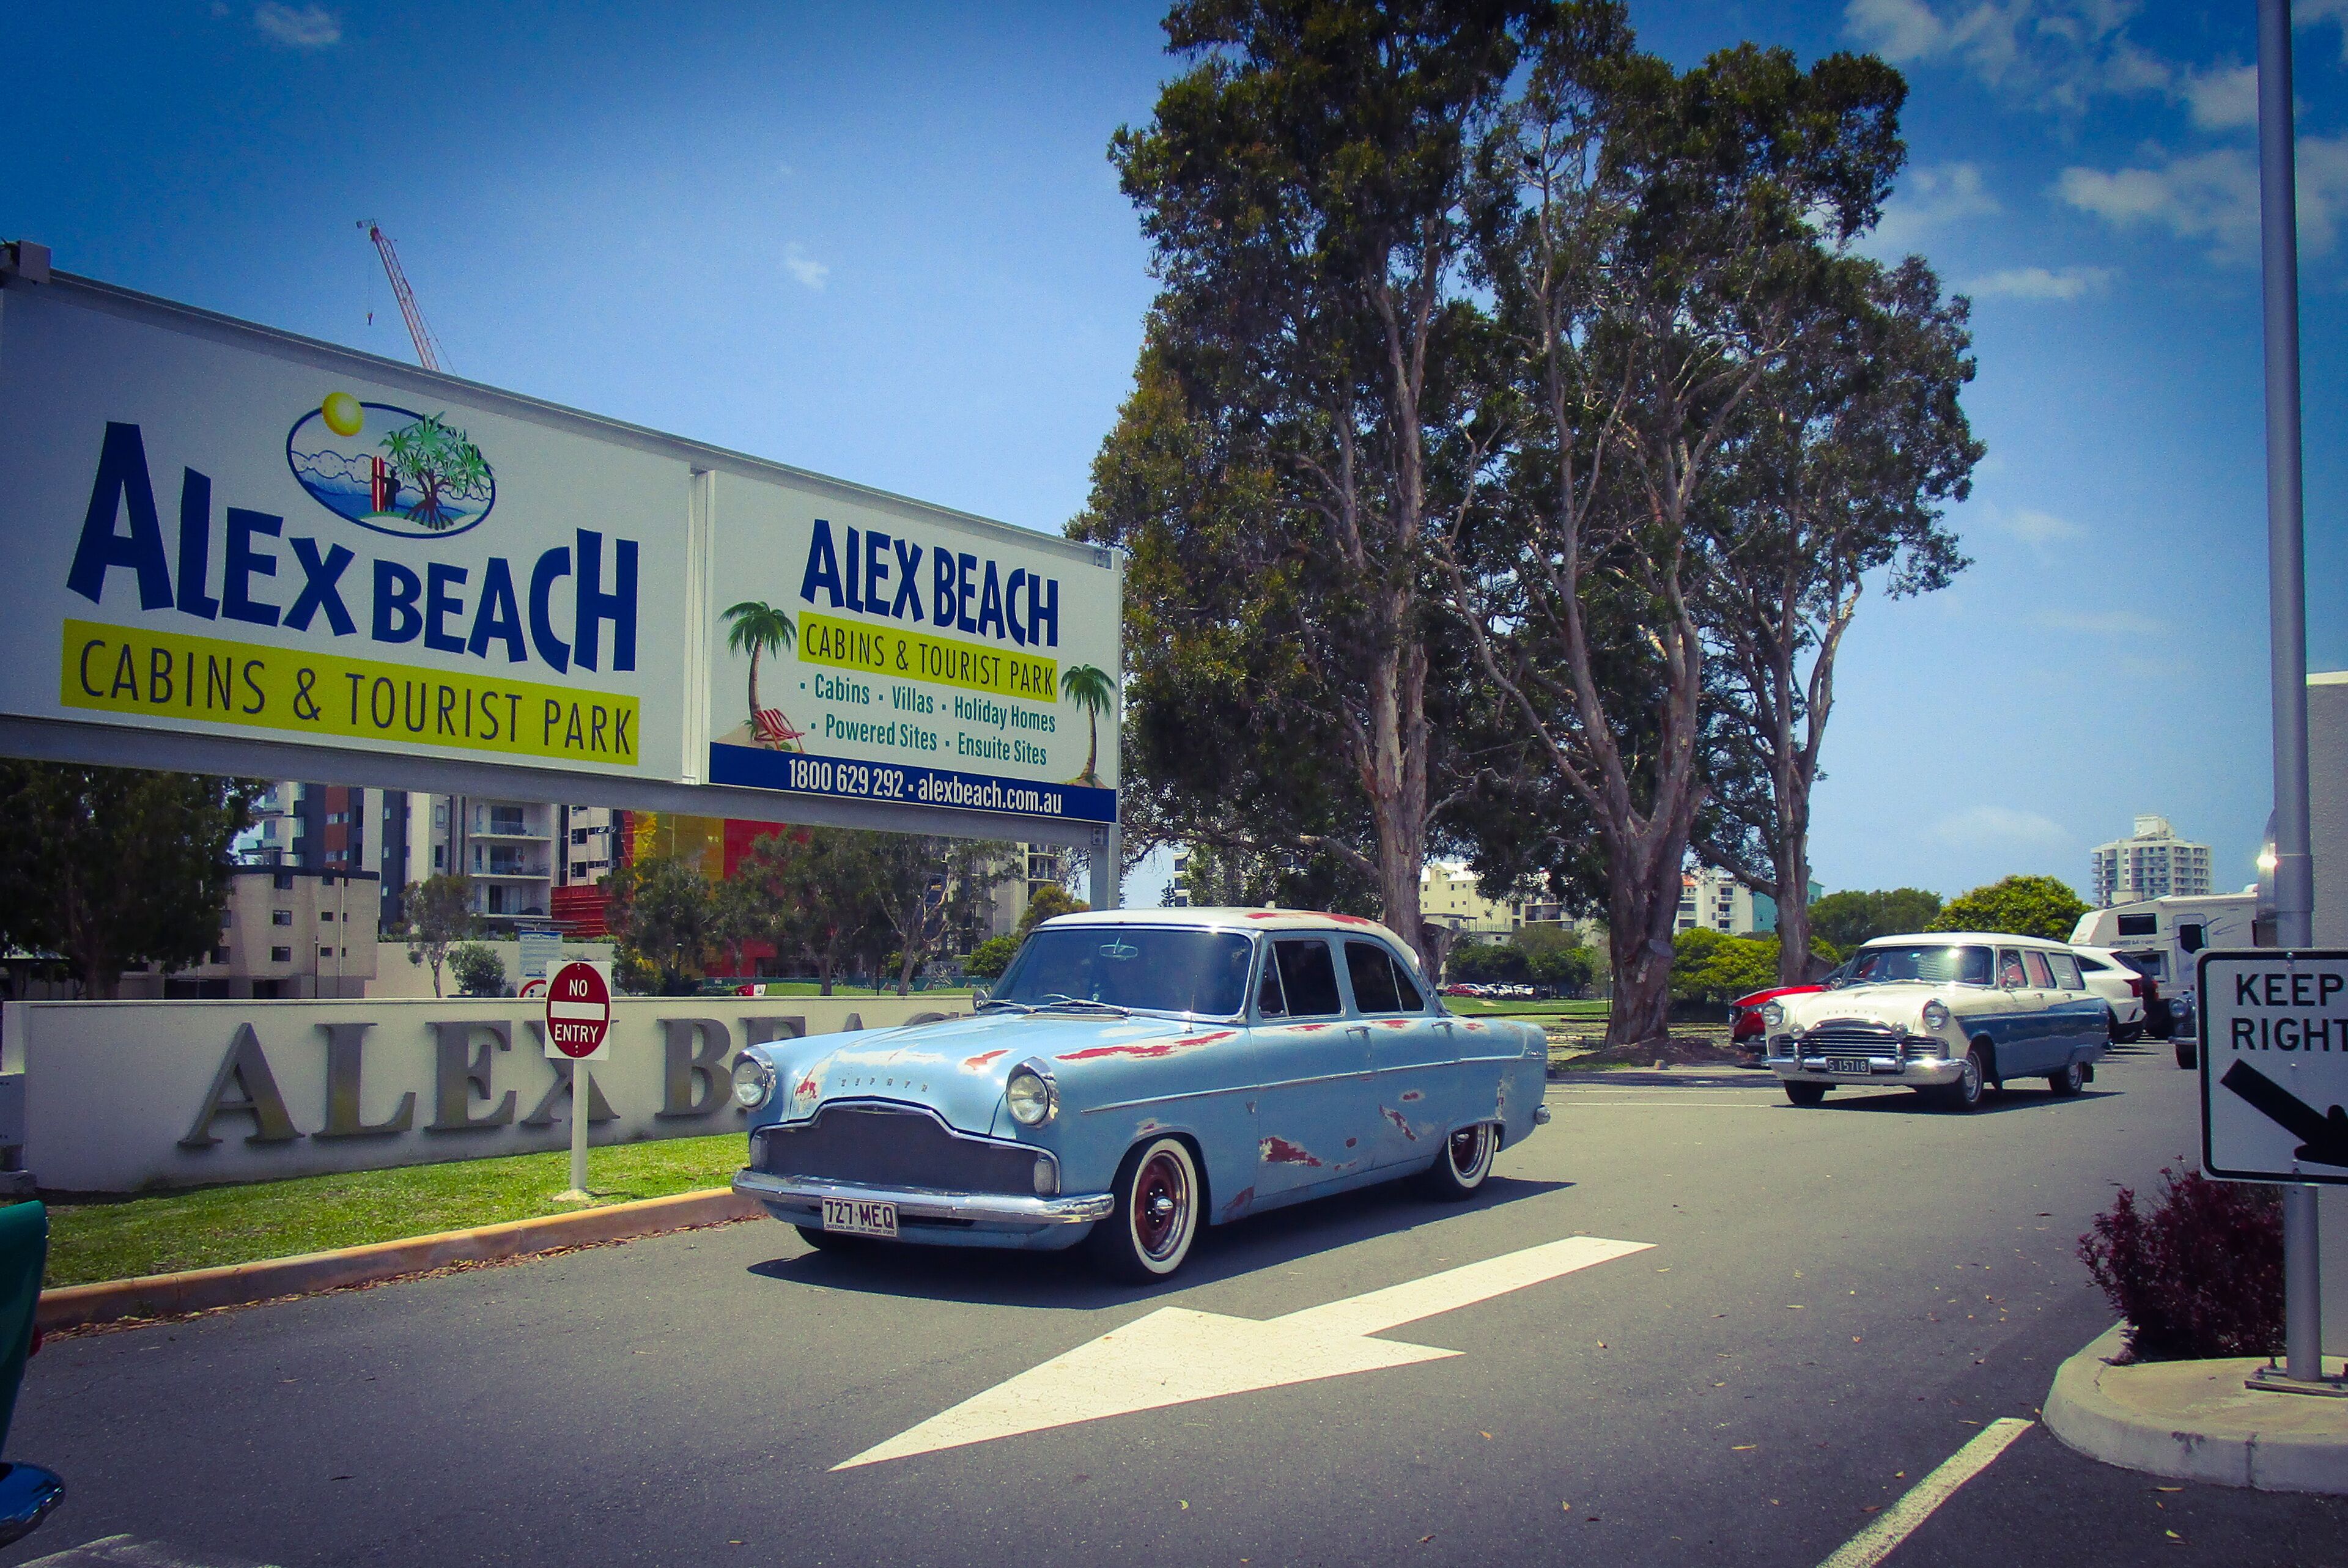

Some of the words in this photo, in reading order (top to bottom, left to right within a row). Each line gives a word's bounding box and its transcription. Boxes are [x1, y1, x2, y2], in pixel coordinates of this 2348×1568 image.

[66, 421, 356, 636] ALEX
[371, 528, 638, 674] BEACH
[800, 519, 924, 622] ALEX
[934, 547, 1058, 647] BEACH
[807, 624, 884, 666] CABINS
[896, 640, 909, 671] &
[918, 643, 1001, 687] TOURIST
[1010, 661, 1054, 696] PARK
[79, 638, 266, 716] CABINS
[293, 668, 322, 721] &
[345, 672, 522, 743] TOURIST
[544, 698, 632, 755] PARK
[815, 673, 870, 705] Cabins
[892, 685, 934, 714] Villas
[954, 695, 1007, 731] Holiday
[1011, 704, 1056, 733] Homes
[825, 713, 895, 746] Powered
[899, 723, 937, 751] Sites
[958, 731, 1010, 761] Ensuite
[1014, 740, 1047, 766] Sites
[789, 759, 832, 791] 1800
[836, 764, 868, 795] 629
[873, 768, 904, 798] 292
[918, 773, 1061, 814] alexbeach.com.au
[569, 979, 588, 997] NO
[2236, 973, 2344, 1007] KEEP
[555, 1023, 599, 1043] ENTRY
[2232, 1017, 2348, 1052] RIGHT
